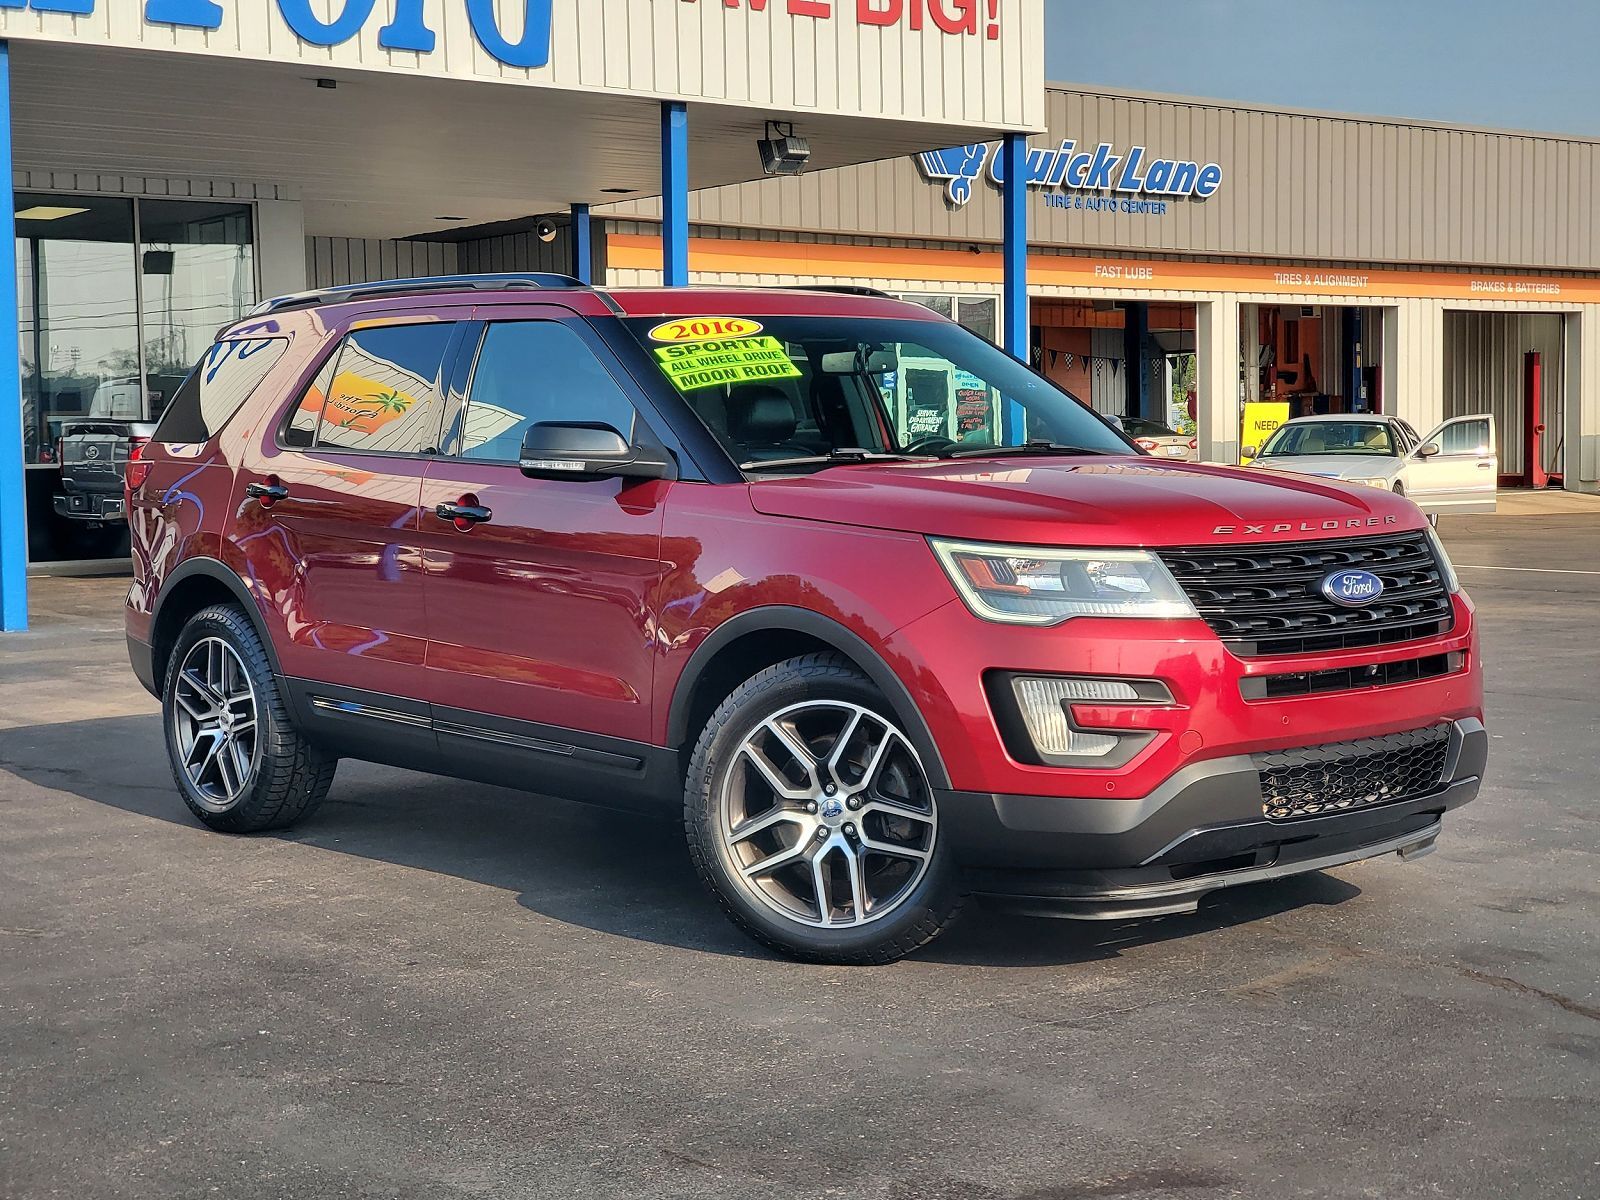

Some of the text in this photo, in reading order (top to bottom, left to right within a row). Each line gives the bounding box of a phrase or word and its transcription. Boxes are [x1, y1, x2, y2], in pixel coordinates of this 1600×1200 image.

[1117, 146, 1222, 198] Lane
[1043, 193, 1166, 215] TIRE & AUTO CENTER
[1095, 265, 1153, 280] FAST LUBE
[1274, 273, 1368, 288] TIRES & ALIGNMENT
[1471, 281, 1560, 294] BRAKES & BATTERIES
[669, 321, 744, 339] 2016
[666, 338, 769, 358] SPORTY
[671, 351, 782, 372] ALL WHEEL DRIVE
[680, 363, 791, 387] MOON ROOF
[1254, 420, 1279, 431] NEED
[1213, 515, 1397, 534] EXPLORER
[1343, 575, 1374, 596] Ford
